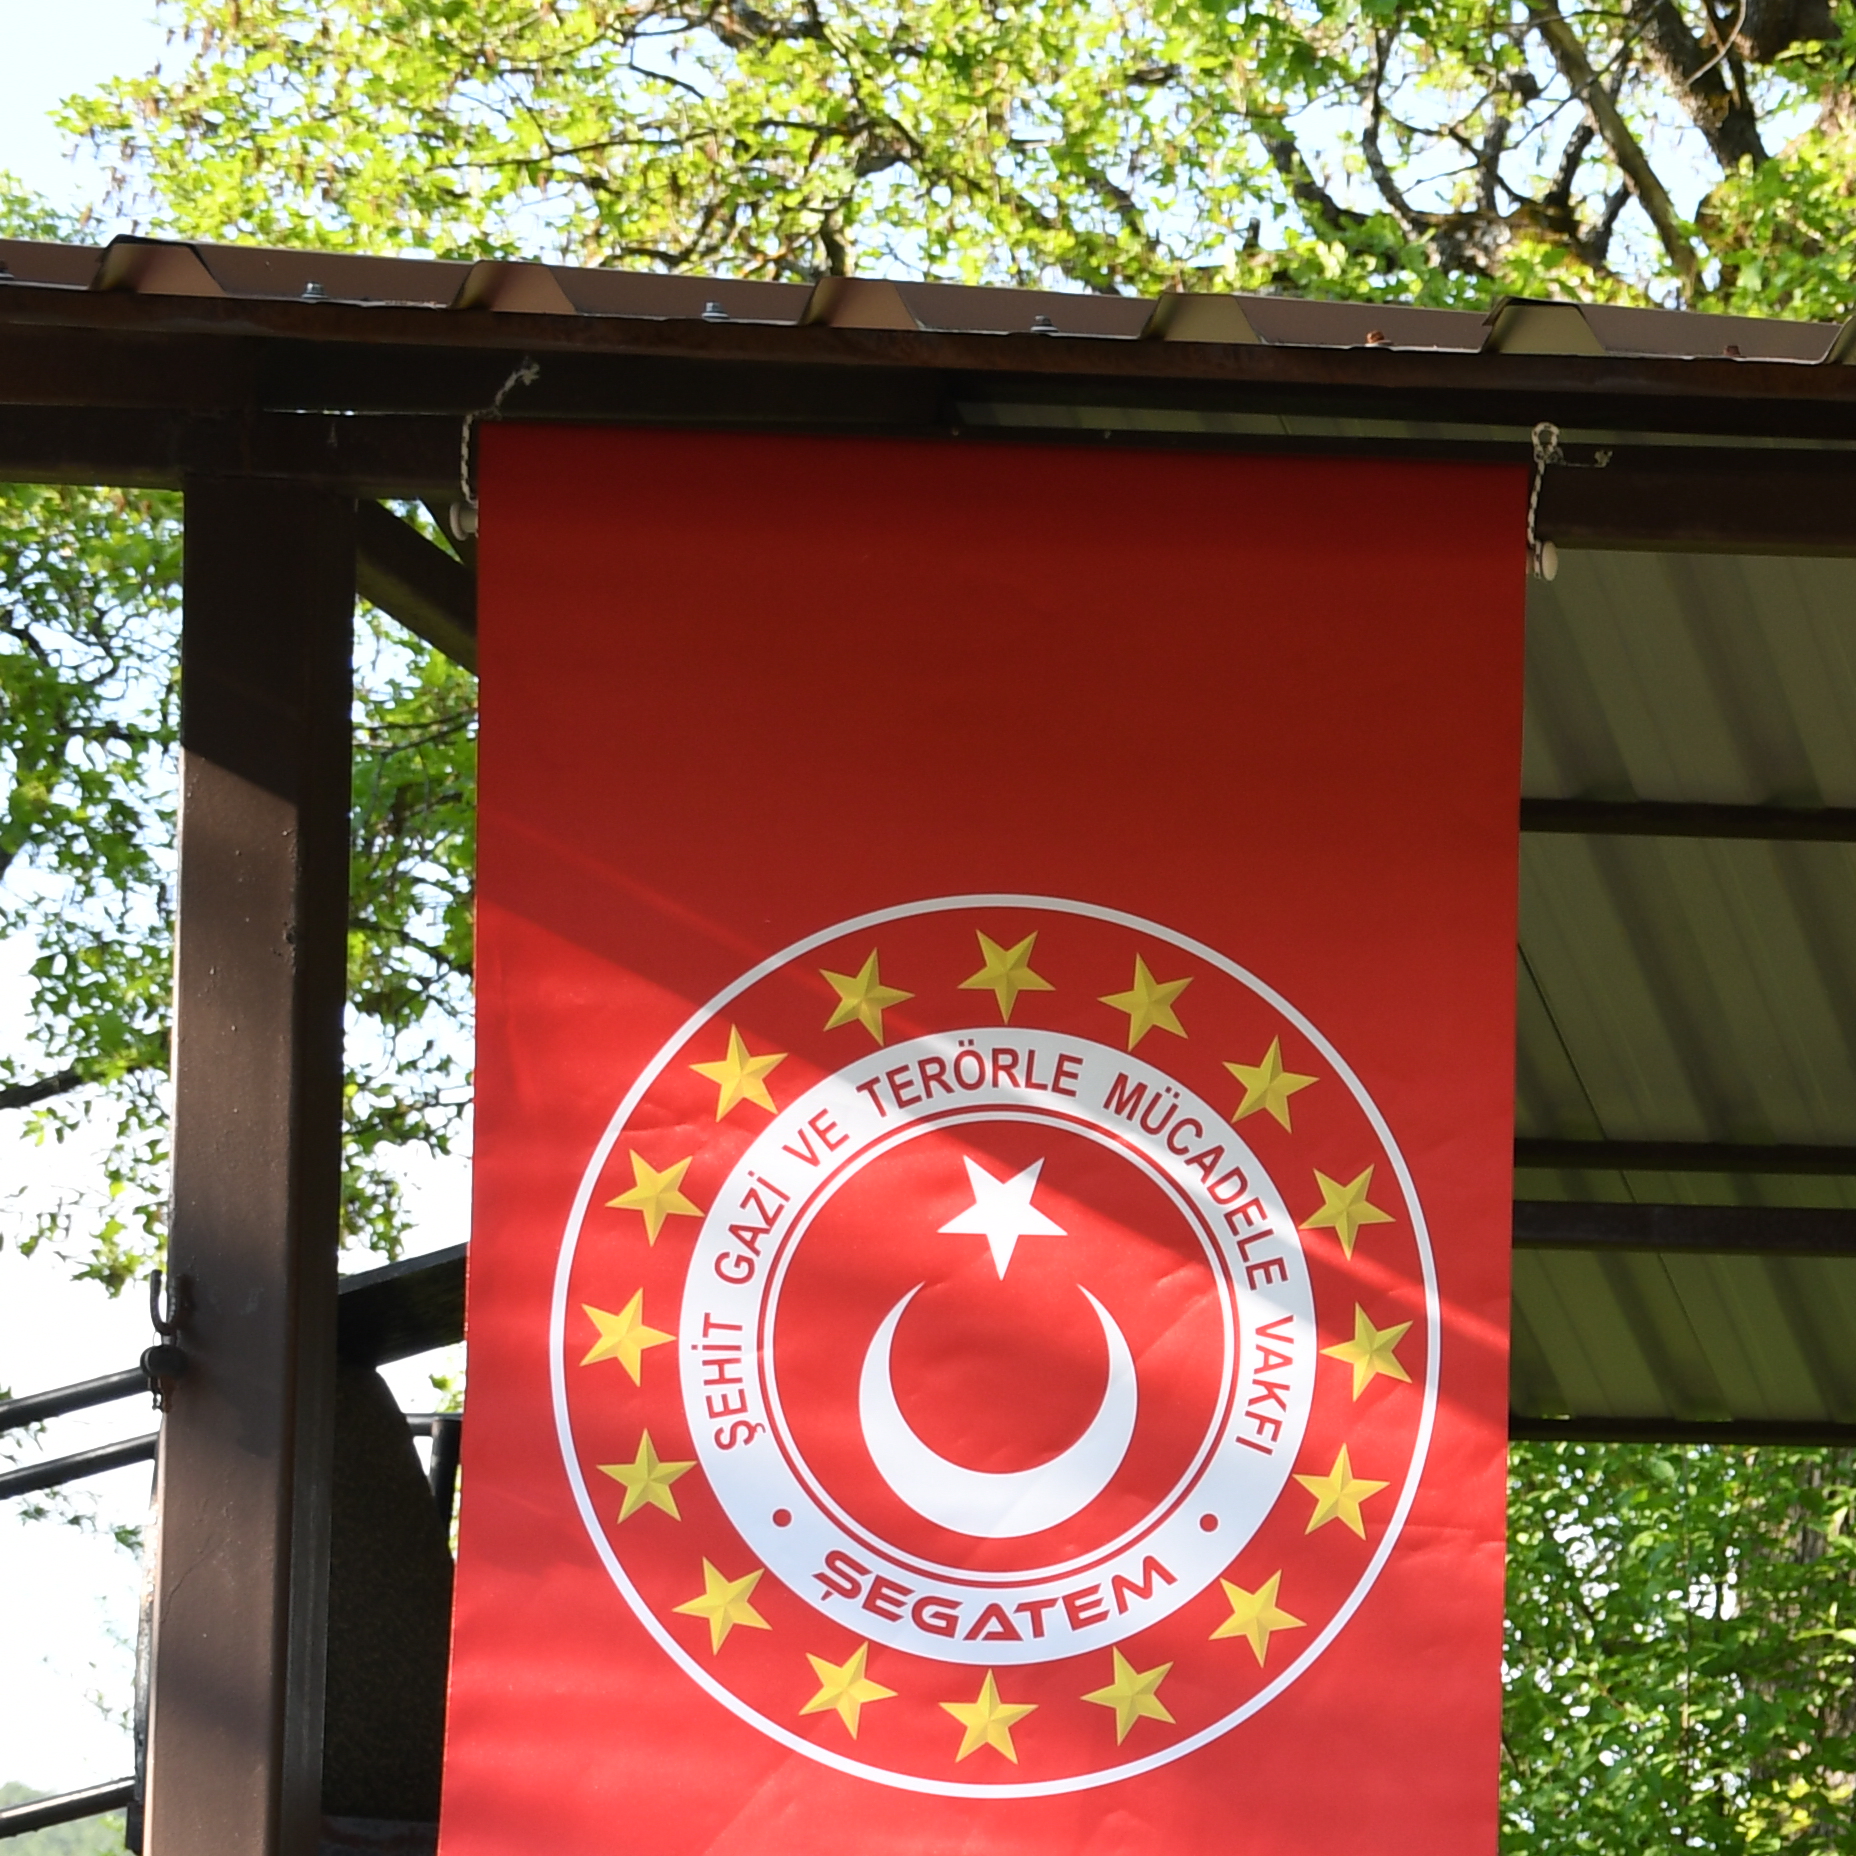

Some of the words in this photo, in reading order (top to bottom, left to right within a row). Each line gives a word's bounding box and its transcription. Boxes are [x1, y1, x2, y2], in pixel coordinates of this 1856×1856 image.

[856, 1038, 1084, 1118] TERÖRLE
[781, 1108, 850, 1168] VE
[1103, 1073, 1288, 1292] MÜCADELE
[713, 1170, 791, 1286] GAZİ
[690, 1311, 766, 1452] ŞEHİT
[1236, 1314, 1295, 1456] VAKFI
[812, 1548, 1178, 1642] ŞEGATEM
